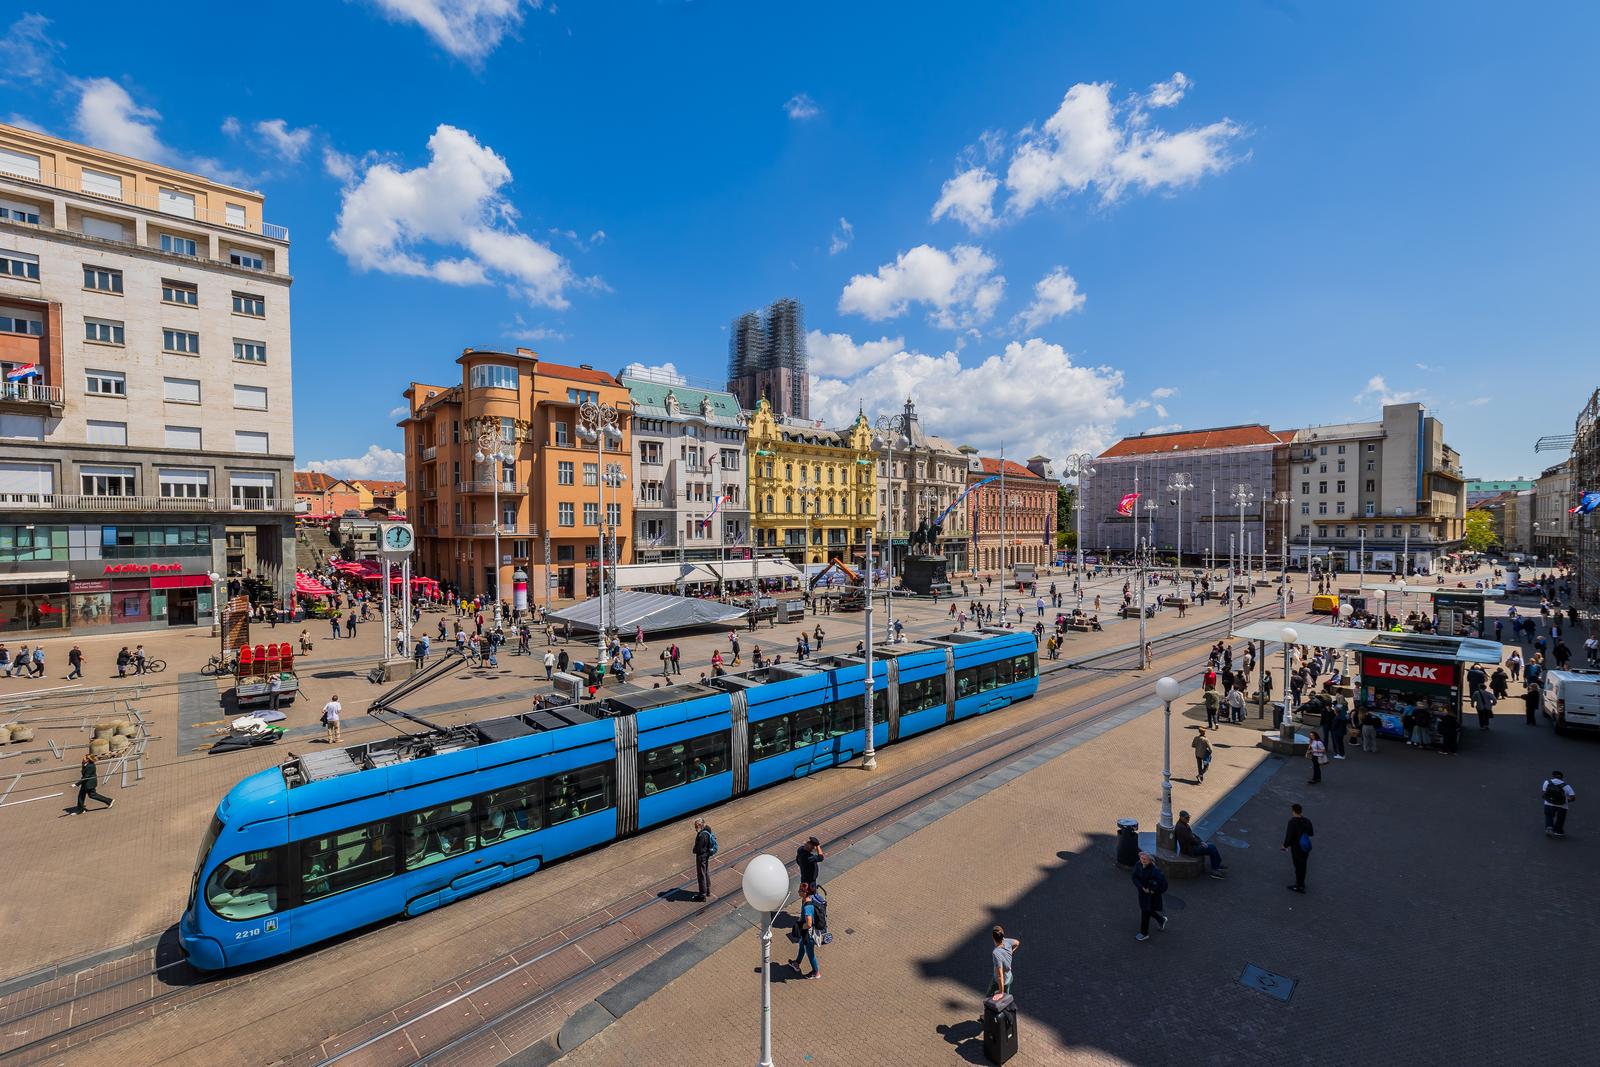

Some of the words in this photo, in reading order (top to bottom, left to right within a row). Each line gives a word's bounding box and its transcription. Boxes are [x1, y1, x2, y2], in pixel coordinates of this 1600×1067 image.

[103, 563, 149, 574] Addiko
[150, 562, 183, 572] Bank
[1378, 662, 1438, 680] TISAK
[235, 928, 260, 940] 2210
